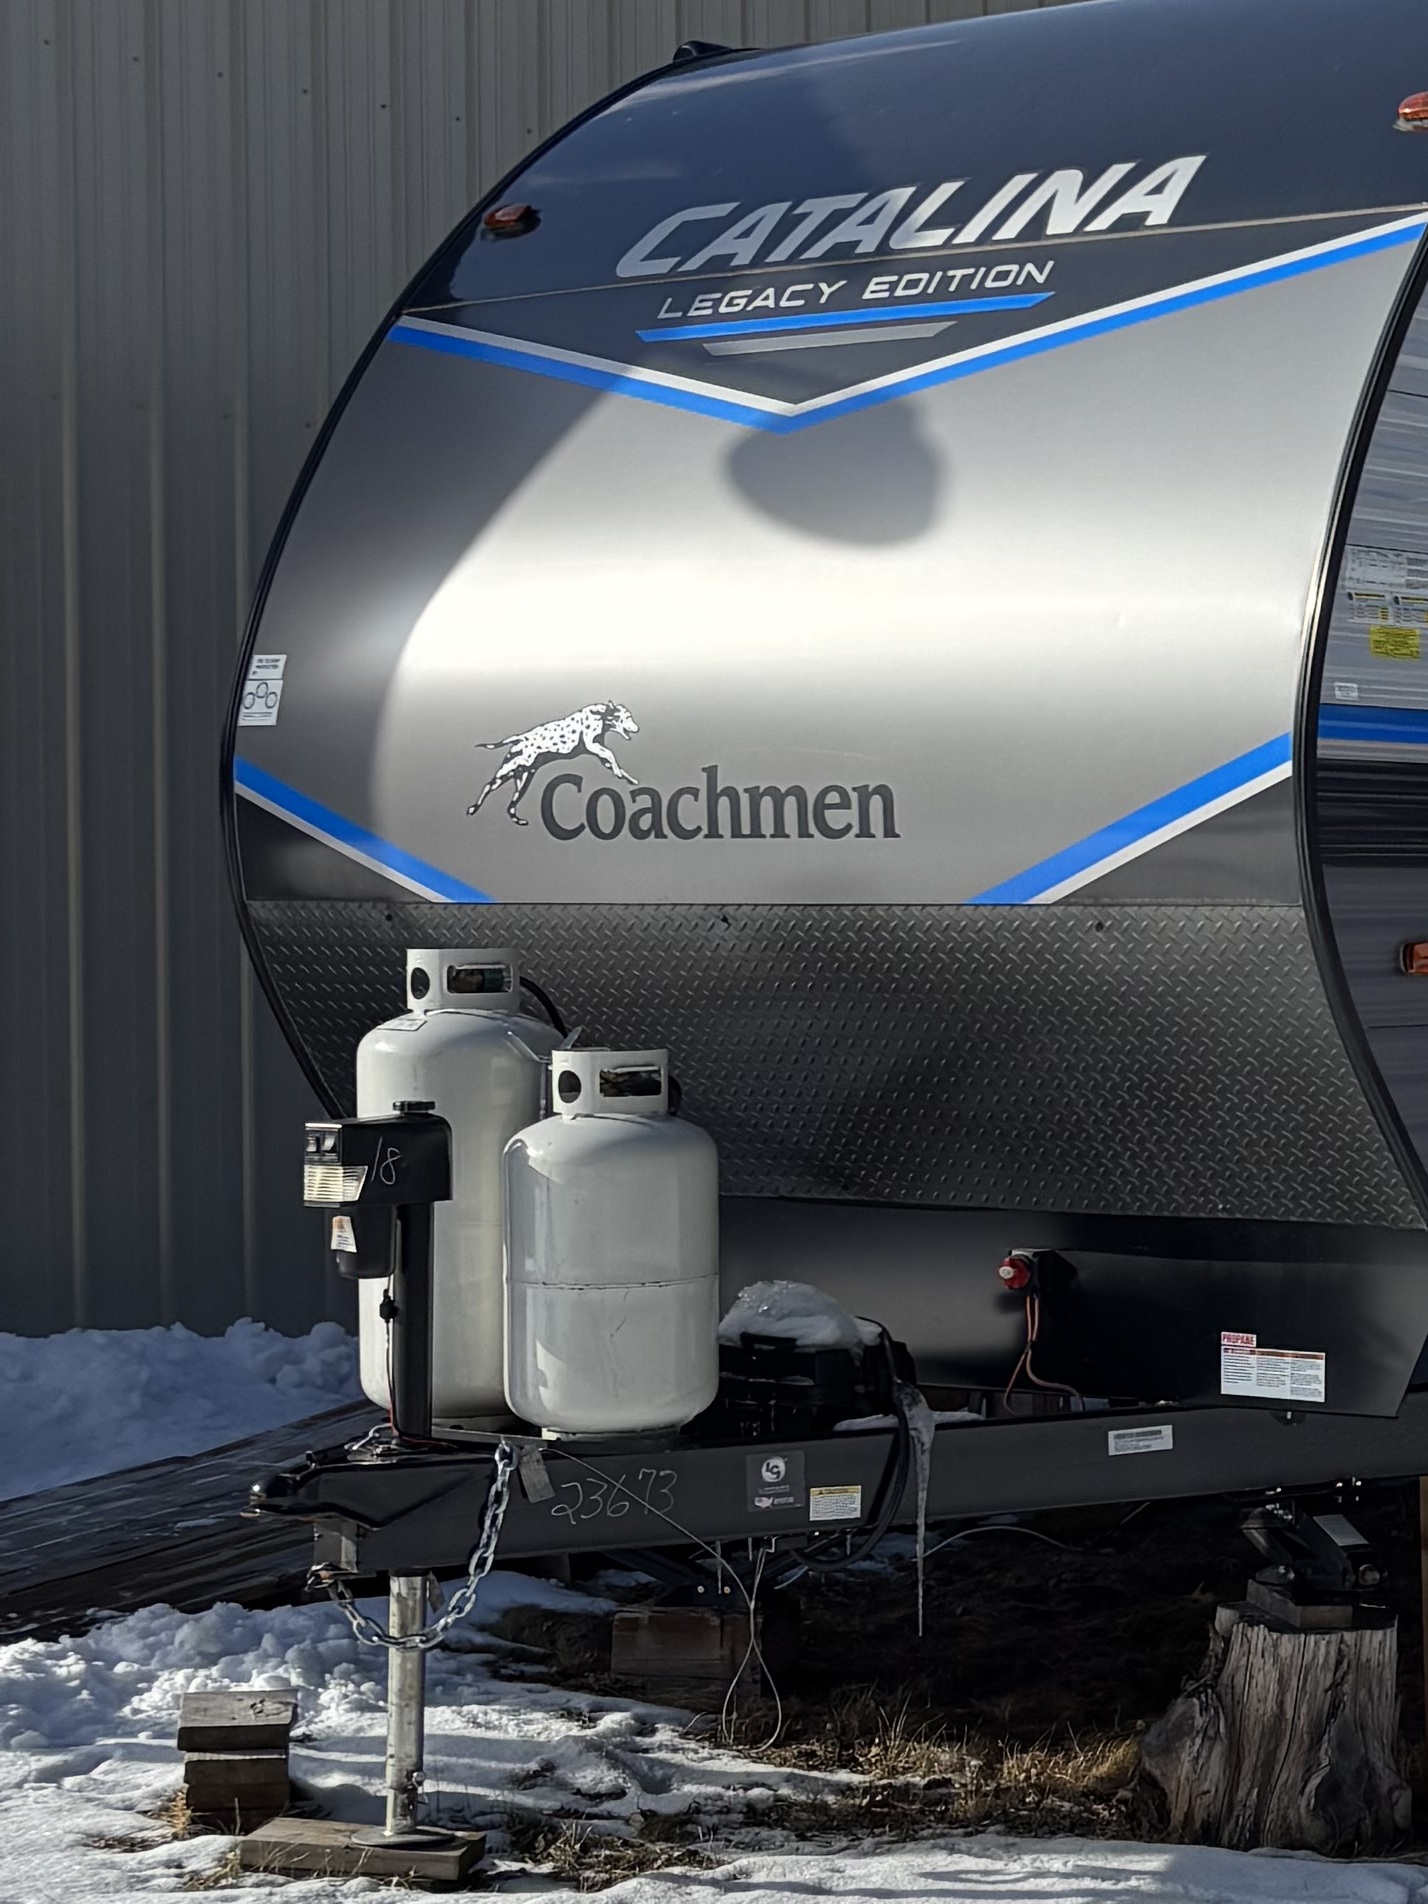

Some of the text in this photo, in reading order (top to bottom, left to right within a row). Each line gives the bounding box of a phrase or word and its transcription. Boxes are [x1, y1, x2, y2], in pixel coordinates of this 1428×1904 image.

[615, 153, 1208, 279] CATALINA
[657, 259, 1056, 321] LEGACY EDITION
[540, 764, 901, 841] Coachmen
[370, 1135, 402, 1186] 18
[551, 1467, 678, 1525] 23673
